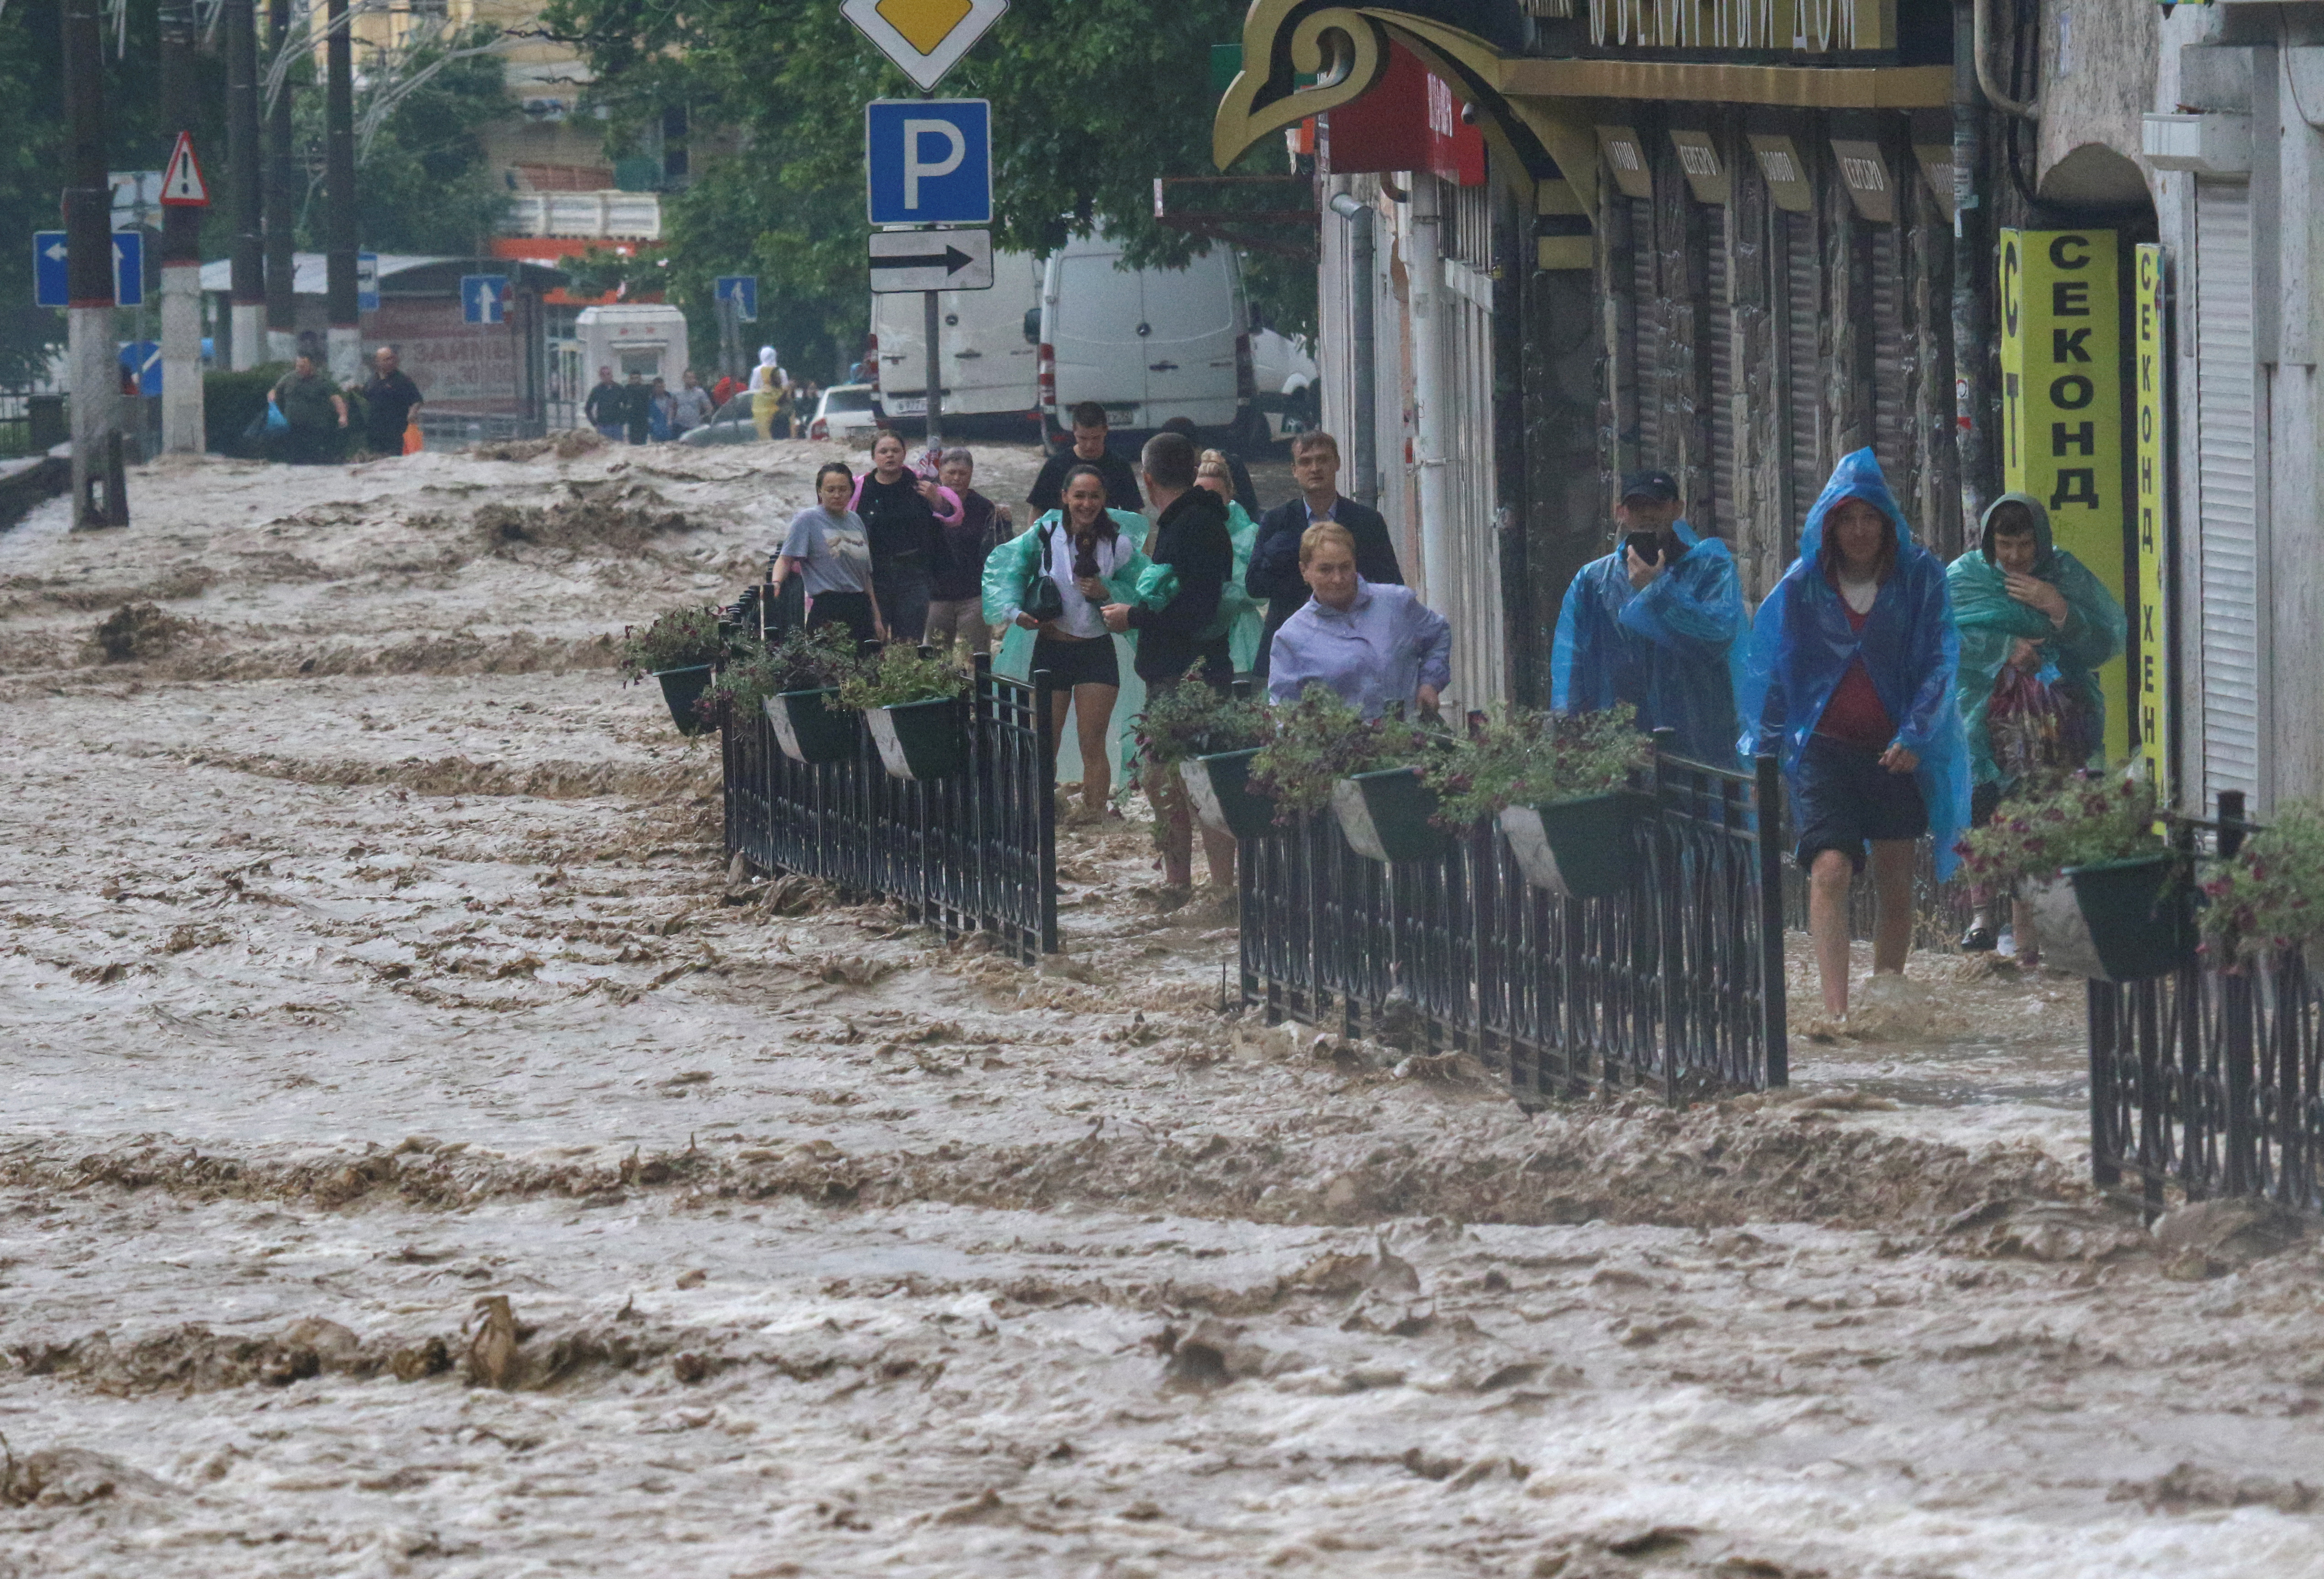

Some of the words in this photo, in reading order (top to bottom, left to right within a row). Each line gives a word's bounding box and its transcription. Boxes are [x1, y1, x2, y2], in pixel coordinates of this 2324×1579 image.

[903, 119, 966, 210] P
[1843, 157, 1884, 192] СЕРЕБРО
[2049, 234, 2099, 511] СЕКОНД
[2141, 252, 2153, 554] СЕКОНД
